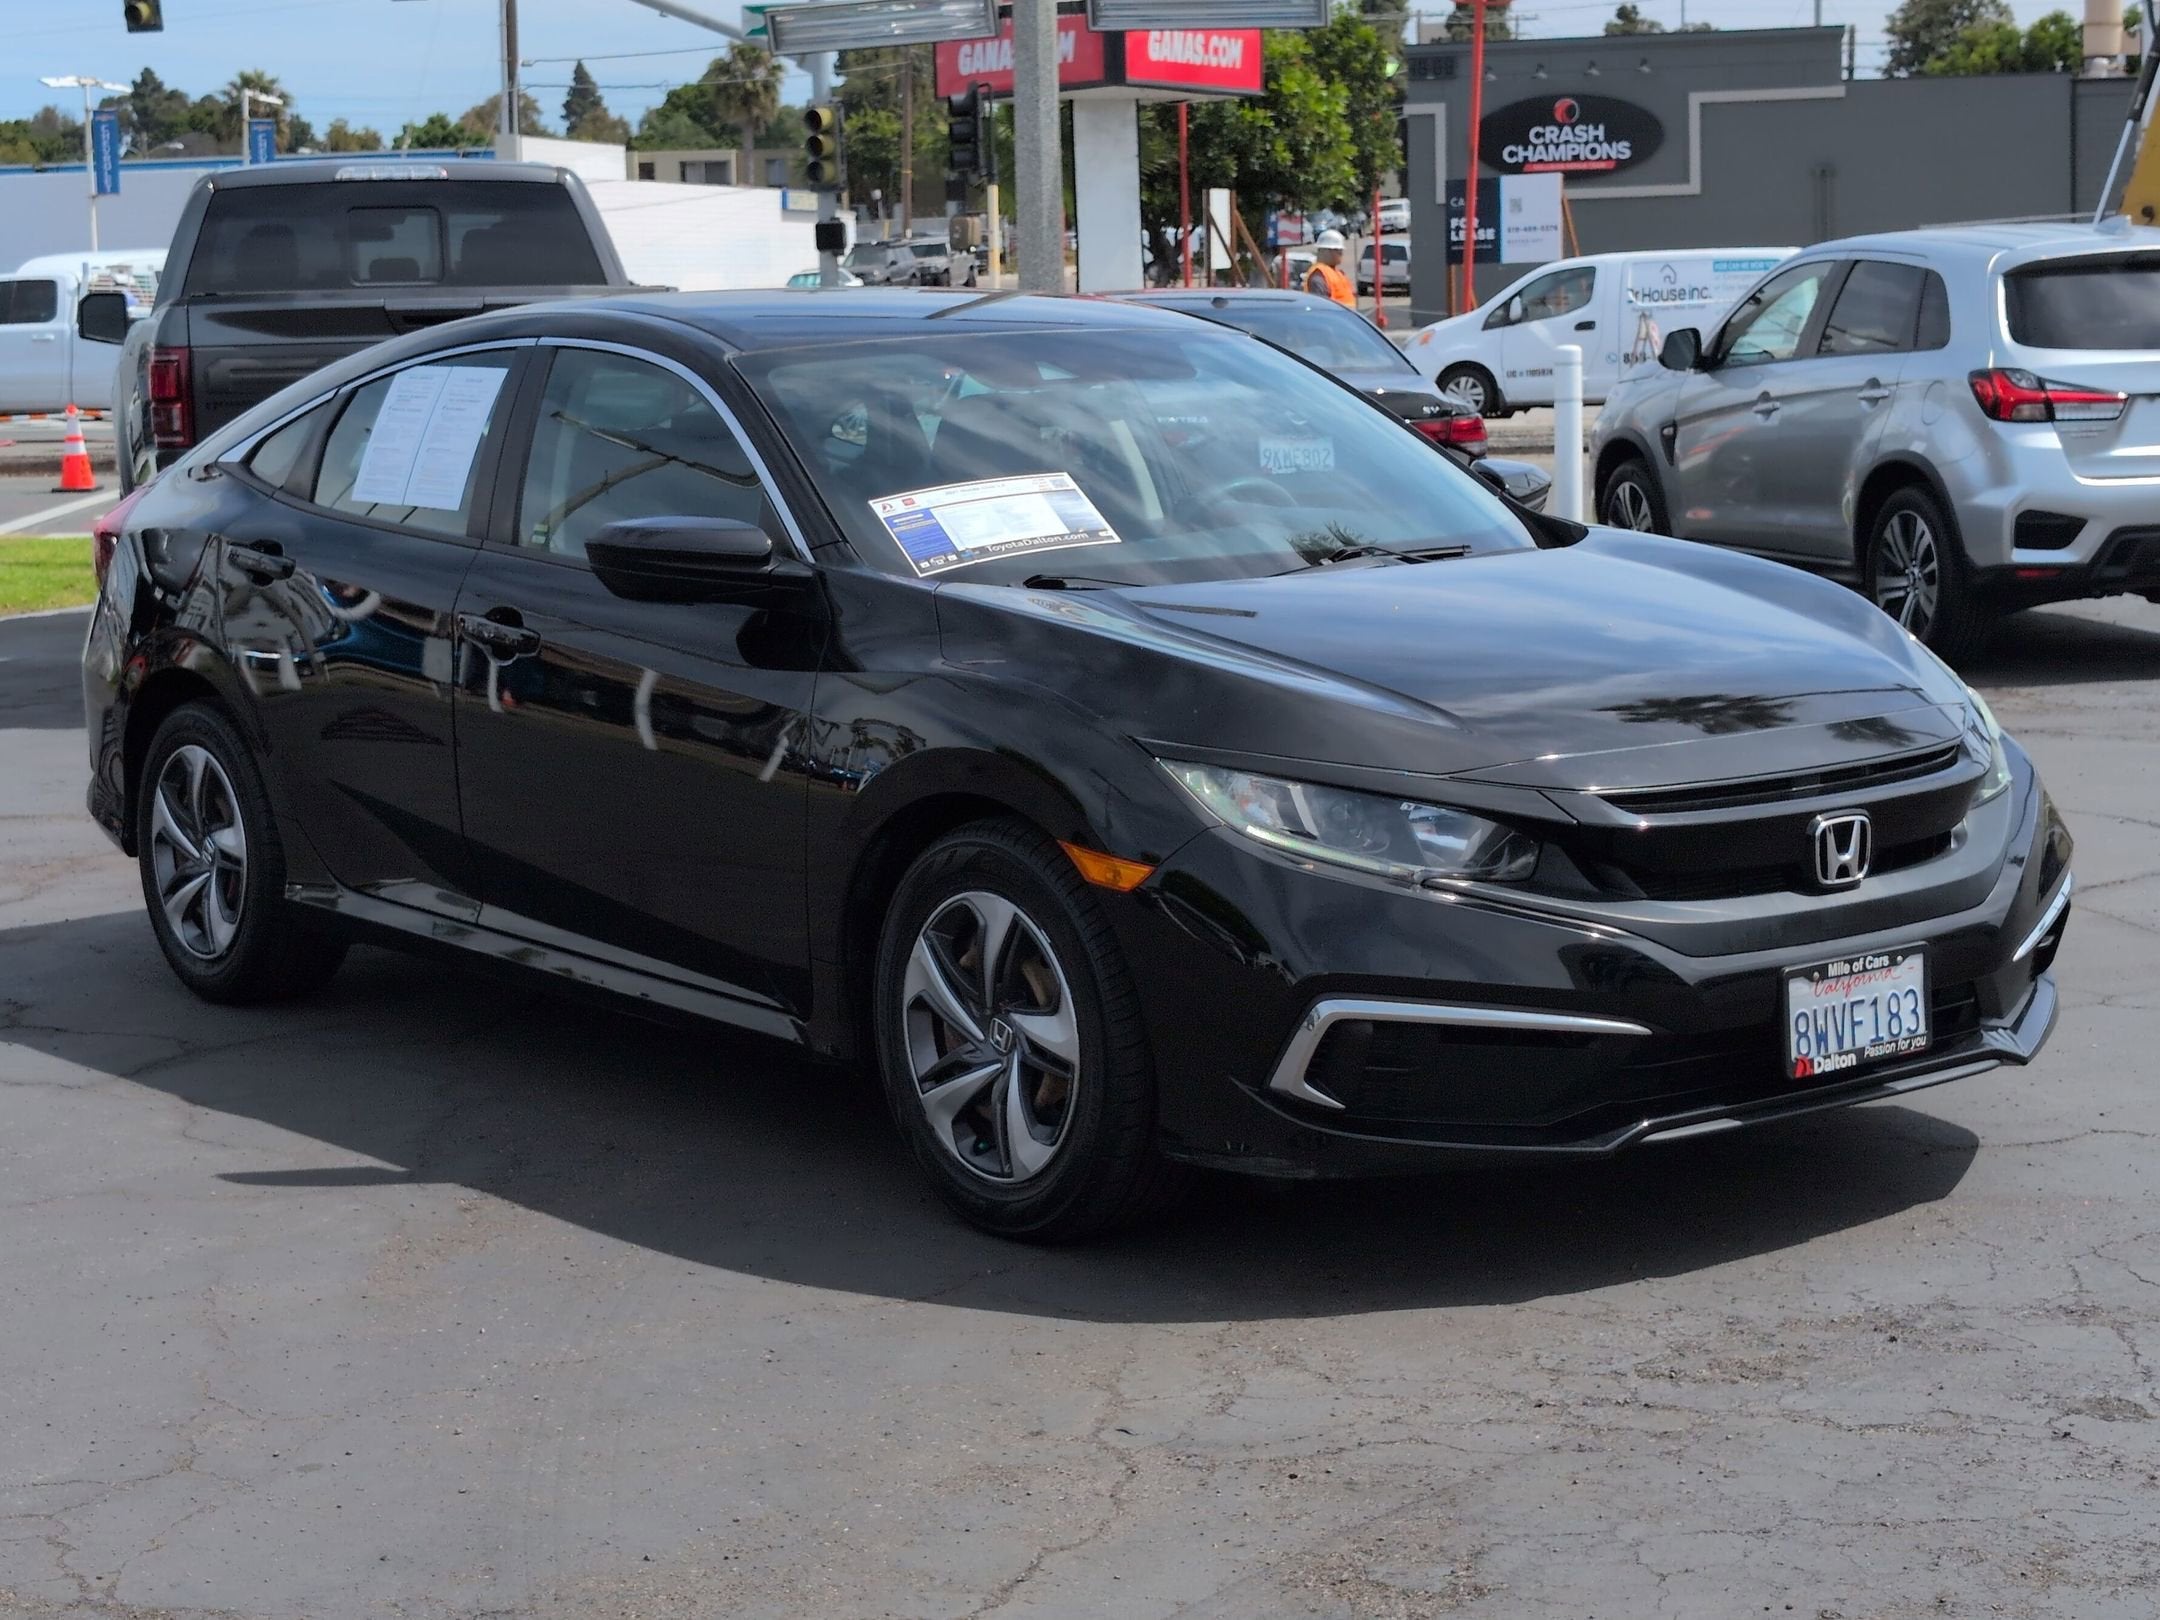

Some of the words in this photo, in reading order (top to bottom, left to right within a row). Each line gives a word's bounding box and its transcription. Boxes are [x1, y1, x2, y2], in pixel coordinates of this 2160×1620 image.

[958, 31, 1075, 76] GANAM
[1148, 30, 1243, 69] GANAS.COM
[1529, 124, 1605, 144] CRASH
[1502, 141, 1632, 163] CHAMPIONS
[1641, 288, 1686, 302] House
[1263, 448, 1330, 469] 9KME802
[985, 530, 1089, 552] ToyotaDalton.com
[1828, 962, 1850, 978] Mile
[1852, 958, 1865, 973] of
[1865, 955, 1889, 970] Cars
[1814, 966, 1901, 997] California
[1795, 988, 1920, 1057] 8WVF183
[1864, 1041, 1896, 1059] Passion
[1897, 1039, 1910, 1052] for
[1910, 1036, 1927, 1051] you
[1814, 1053, 1857, 1074] Dalton
